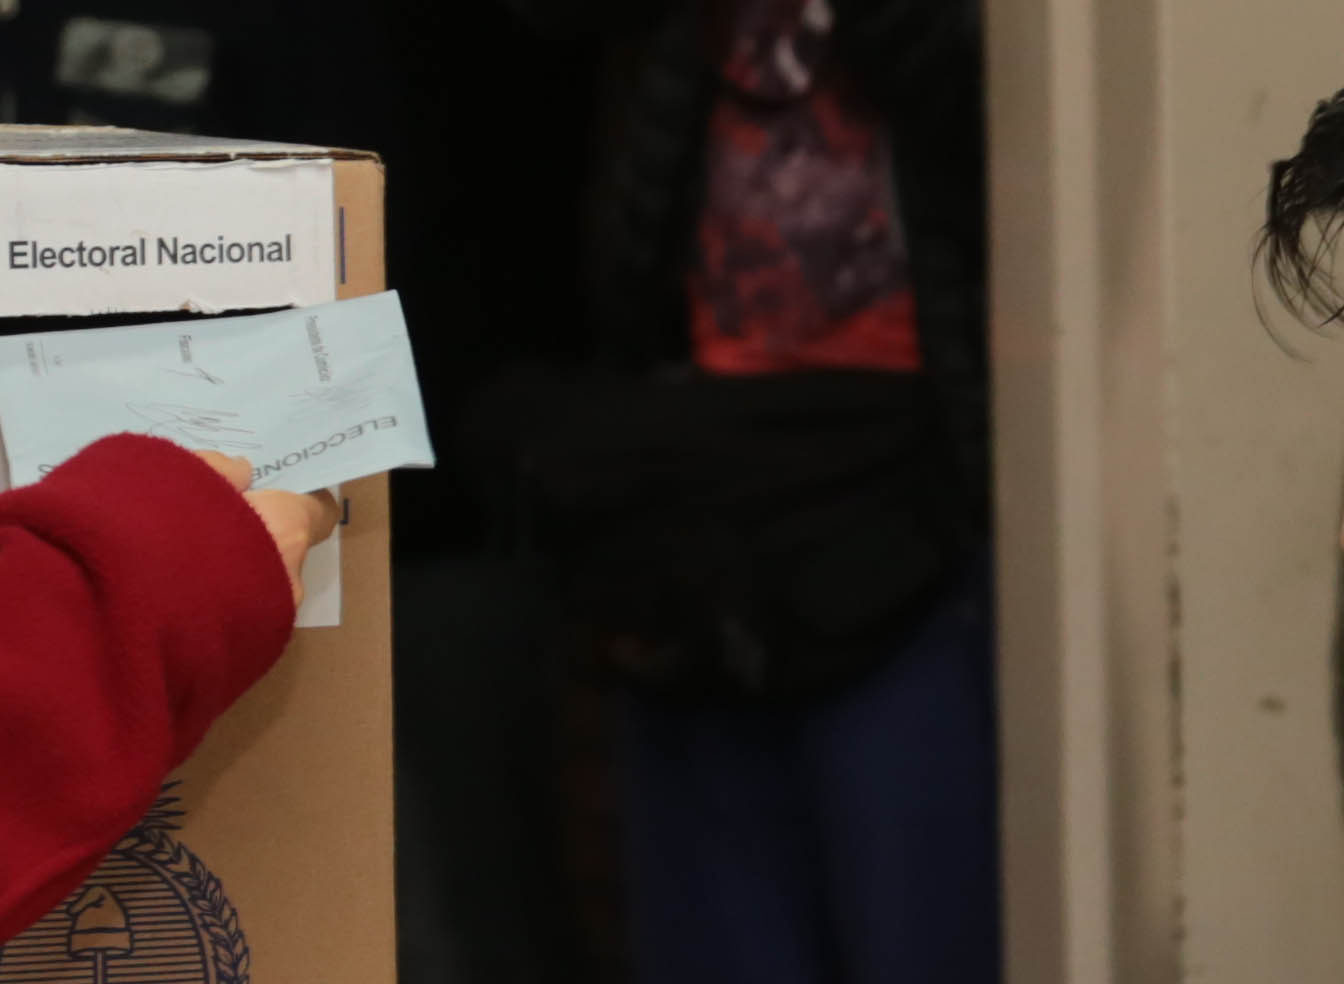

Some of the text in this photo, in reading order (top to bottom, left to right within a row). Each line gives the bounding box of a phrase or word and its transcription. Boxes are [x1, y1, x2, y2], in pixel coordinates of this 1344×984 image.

[8, 237, 147, 269] Electoral
[156, 233, 293, 265] Nacional
[252, 414, 398, 481] ELECCIONE
